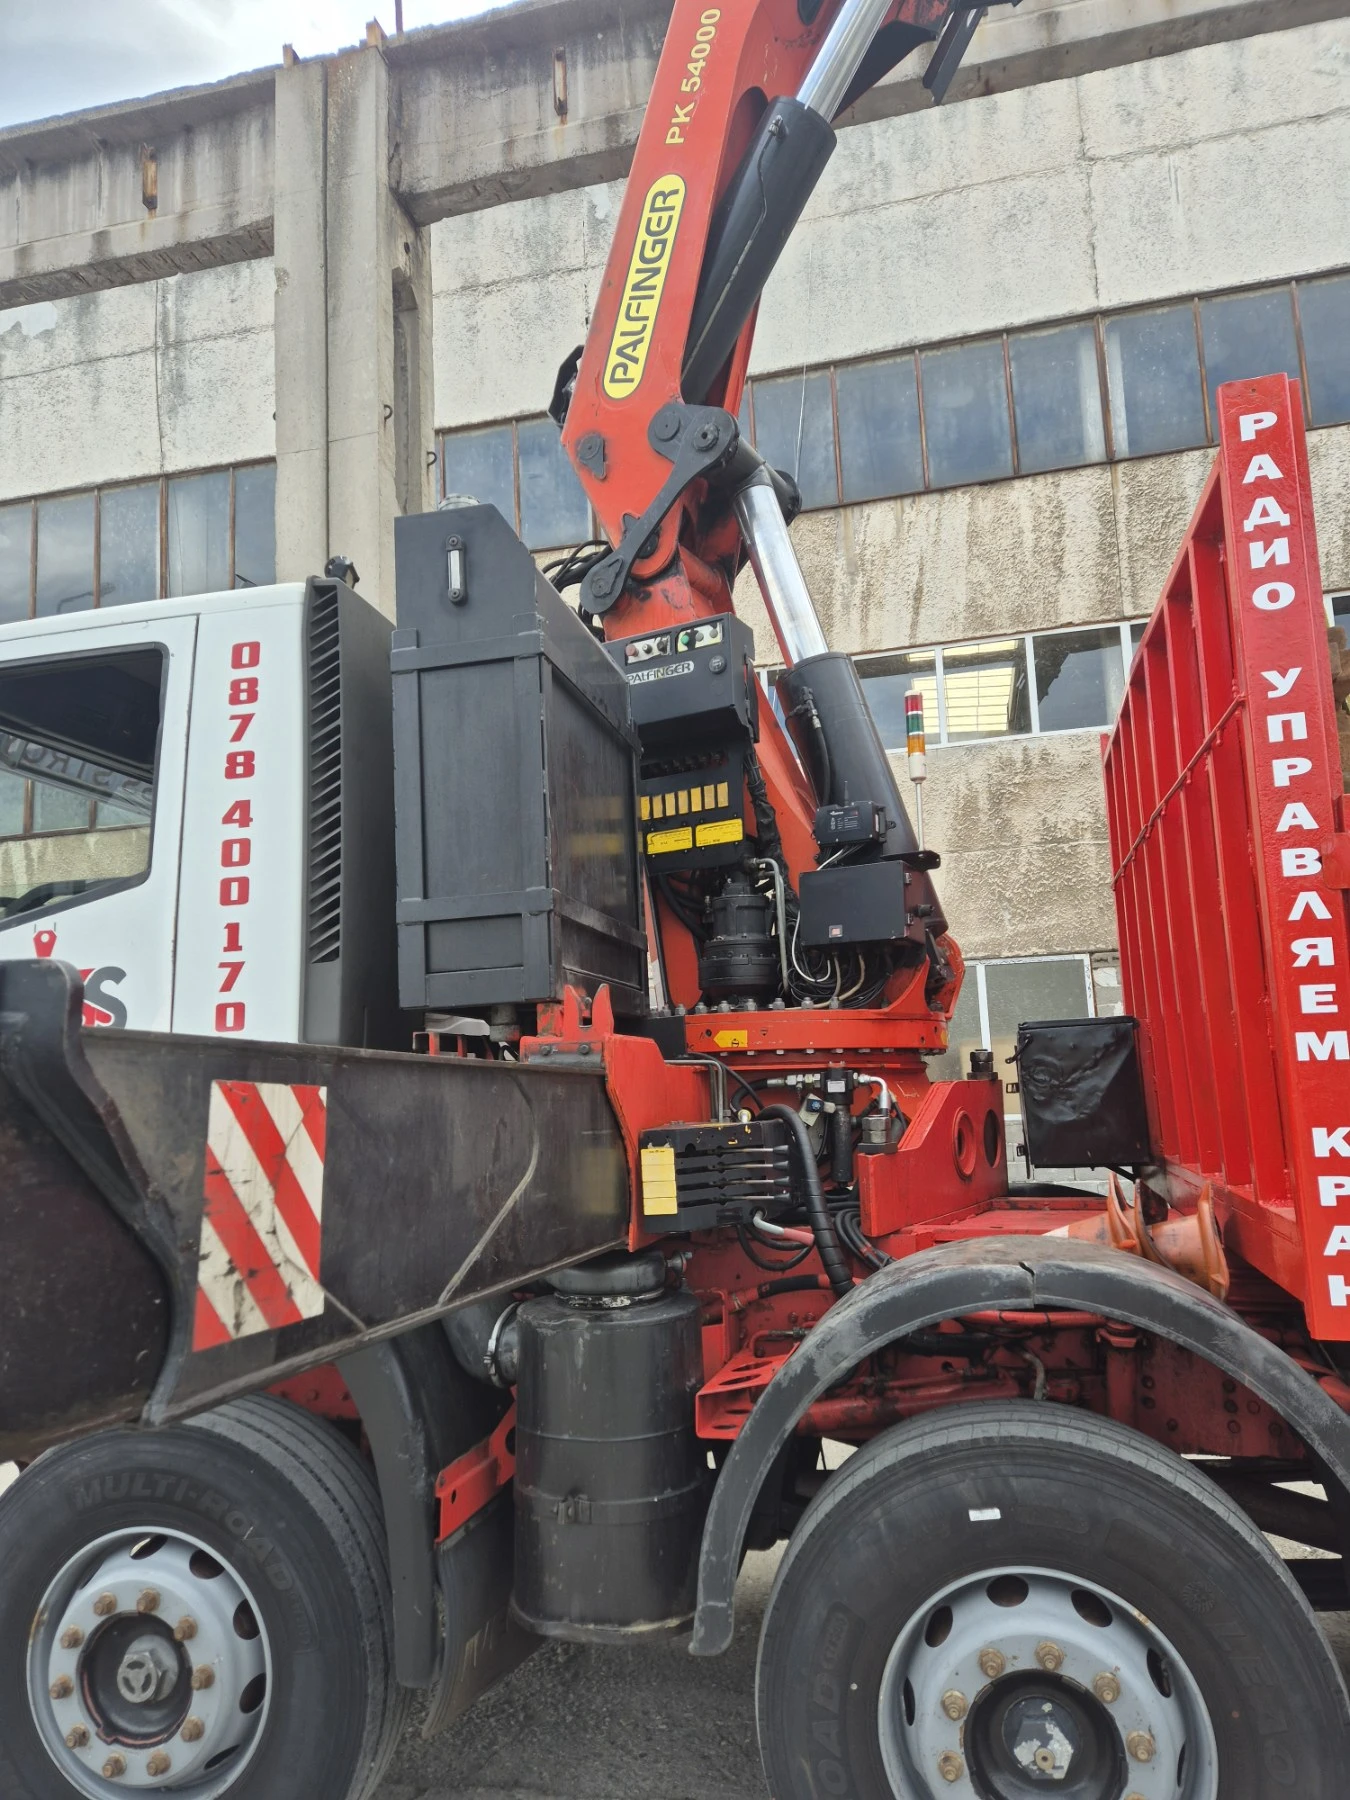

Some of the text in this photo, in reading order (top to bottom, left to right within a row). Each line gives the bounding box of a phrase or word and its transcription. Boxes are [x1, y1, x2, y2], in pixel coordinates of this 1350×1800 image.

[665, 8, 721, 145] PK 54000
[609, 187, 680, 384] PALFINGER
[1238, 411, 1296, 611] РАДИО
[626, 661, 692, 683] PALFINGER
[215, 641, 261, 1032] 0878 400 170
[1260, 666, 1350, 1062] УПРАВЛЯЕМ
[73, 1472, 294, 1592] MULTI-ROAD
